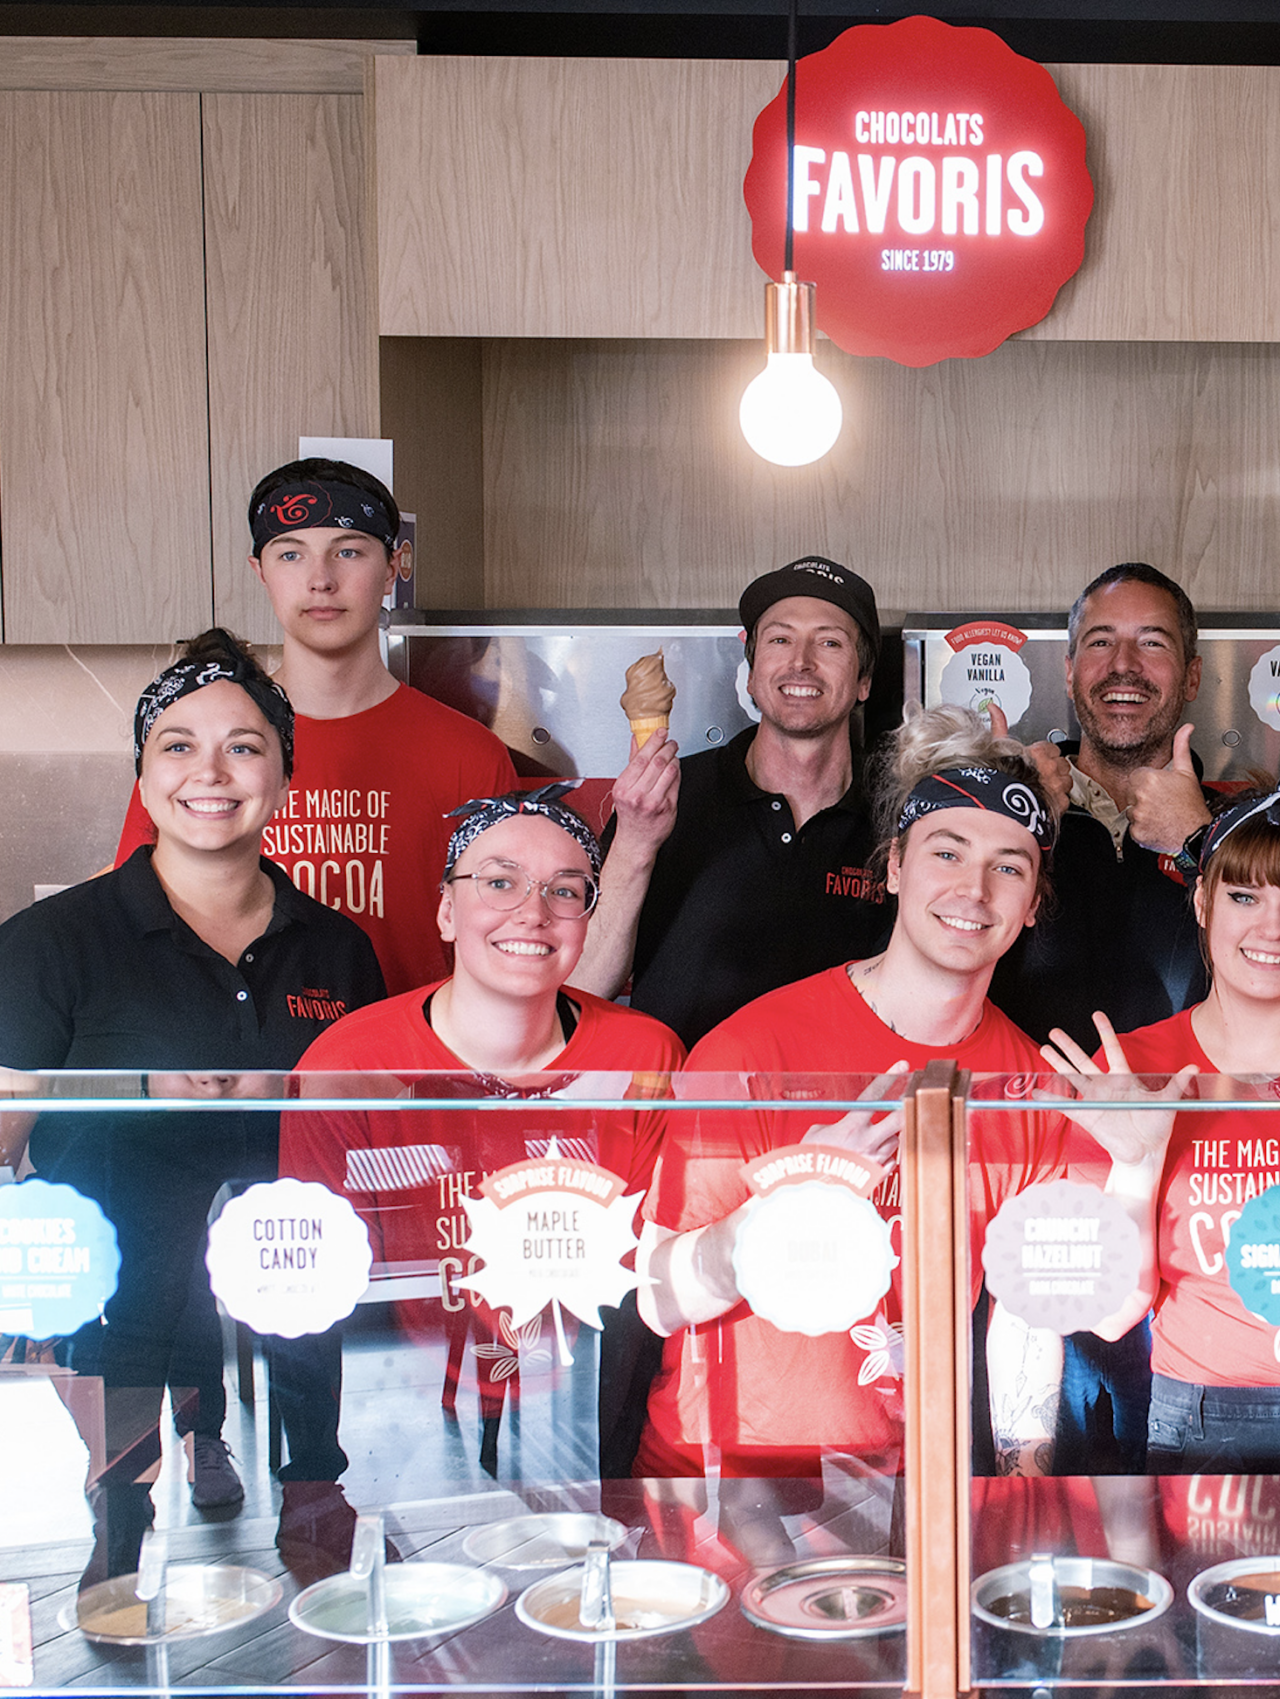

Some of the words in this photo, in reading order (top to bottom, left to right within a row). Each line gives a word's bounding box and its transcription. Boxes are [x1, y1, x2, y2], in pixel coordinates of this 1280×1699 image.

[855, 110, 984, 145] CHOCOLATS
[792, 144, 1044, 236] FAVORIS
[881, 249, 919, 271] SINCE
[922, 250, 954, 271] 1979
[971, 653, 1002, 666] VEGAN
[967, 669, 1005, 681] VANILLA
[306, 789, 361, 818] MAGIC
[367, 790, 391, 818] OF
[262, 824, 391, 856] SUSTAINABLE
[275, 859, 384, 919] OCOA
[826, 872, 885, 905] FAVORIS
[286, 994, 347, 1020] FAVORIS
[1192, 1140, 1230, 1168] THE
[493, 1166, 556, 1199] SURPRISE
[558, 1166, 614, 1199] FLAVOUR
[753, 1153, 815, 1190] SURPRISE
[816, 1153, 872, 1190] FLAVOUR
[437, 1170, 476, 1210] THE
[0, 1218, 76, 1245] COOKIES
[253, 1218, 322, 1241] COTTON
[527, 1210, 580, 1232] MAPLE
[1024, 1217, 1100, 1242] CRUNCHY
[0, 1247, 23, 1273] ND
[27, 1247, 90, 1273] CREAM
[260, 1246, 318, 1269] CANDY
[523, 1238, 586, 1259] BUTTER
[1021, 1244, 1103, 1268] HAZELNUT
